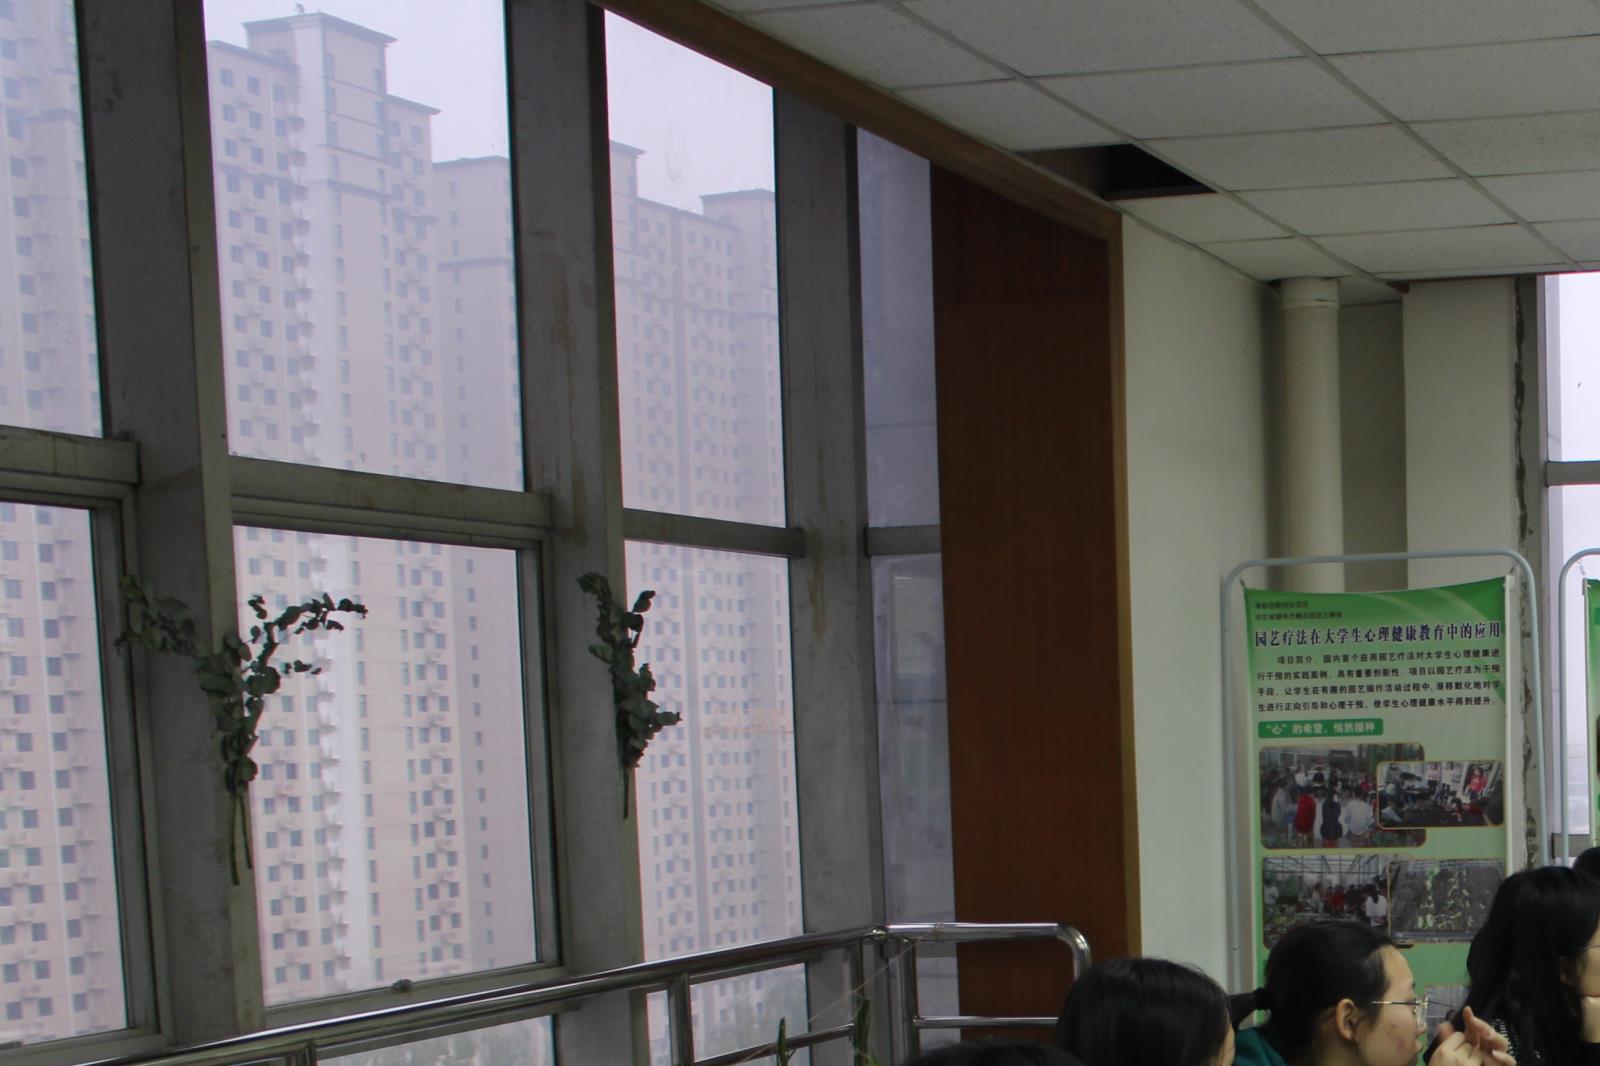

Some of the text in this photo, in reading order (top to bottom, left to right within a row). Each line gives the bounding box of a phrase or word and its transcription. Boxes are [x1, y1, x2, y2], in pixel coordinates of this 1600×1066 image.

[1255, 622, 1500, 647] 园艺疗法在大学生心理健康教育中的应用
